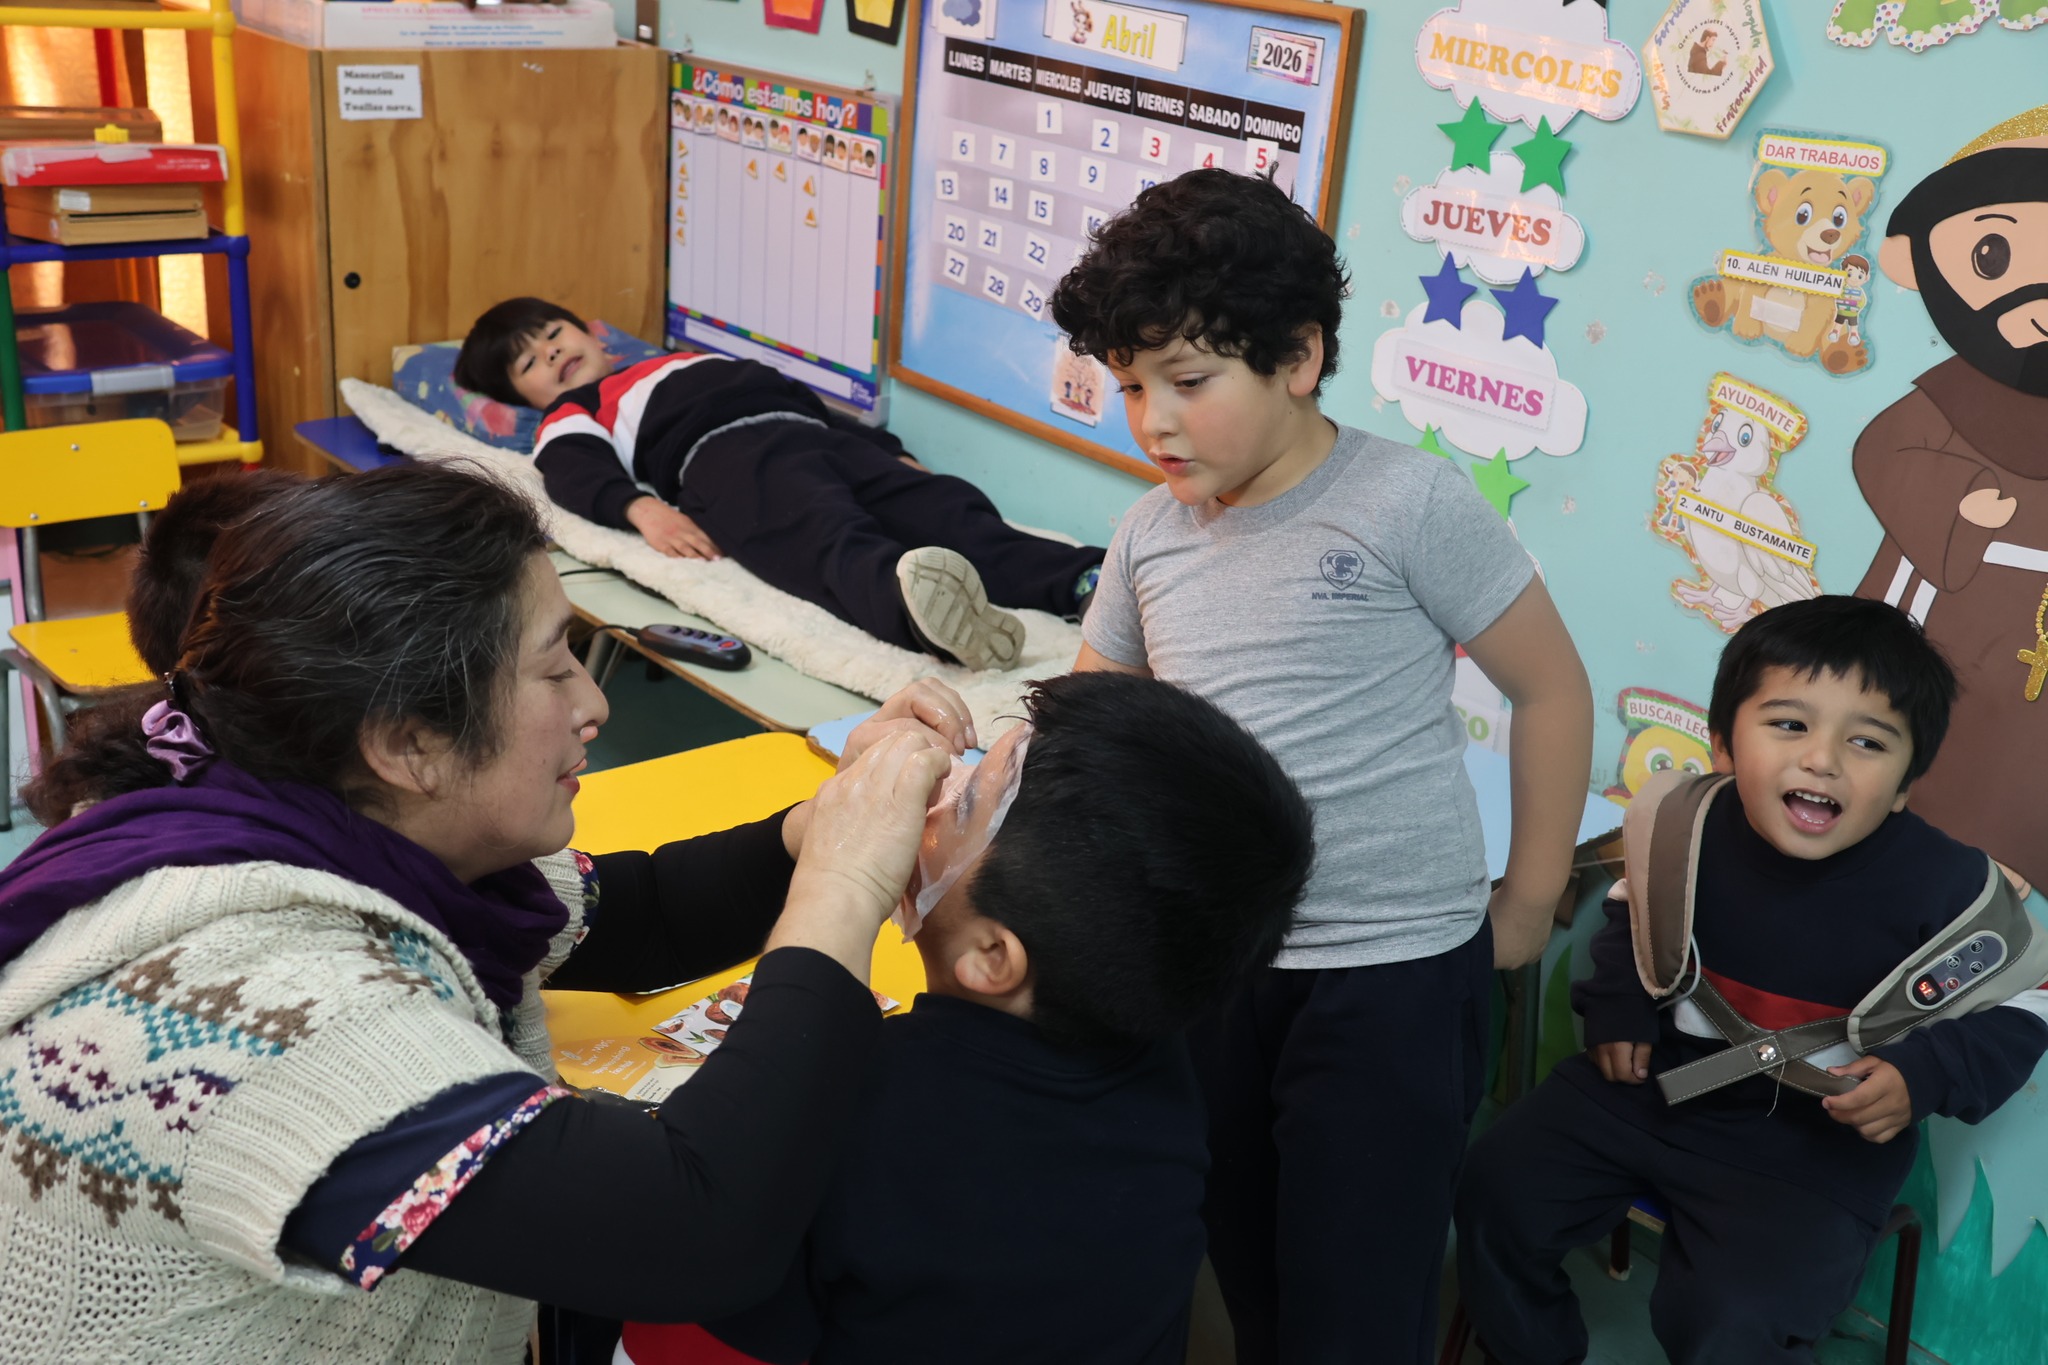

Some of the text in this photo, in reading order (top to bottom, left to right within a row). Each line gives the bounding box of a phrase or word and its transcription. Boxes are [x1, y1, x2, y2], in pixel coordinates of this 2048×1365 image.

[1101, 14, 1157, 59] Abril
[1654, 0, 1689, 46] Servici
[1262, 42, 1302, 73] 2026
[1429, 32, 1622, 99] MIERCOLES
[693, 69, 857, 129] ¿Cómo estamos hoy?
[948, 50, 1301, 143] LUNES MARTES MIERCOLES JUEVES VIERNES SABADO DOMINGO
[959, 138, 968, 156] 6
[998, 143, 1007, 160] 7
[1039, 158, 1049, 175] 8
[1088, 166, 1098, 183] 9
[1045, 109, 1267, 169] 1 2 3 4 5
[1765, 144, 1880, 170] DAR TRABAJOS
[941, 178, 954, 195] 13
[994, 186, 1008, 204] 14
[1034, 199, 1048, 218] 15
[948, 222, 1046, 264] 20 21 22
[1423, 200, 1551, 246] JUEVES
[948, 257, 1042, 313] 27 28 29
[1727, 257, 1842, 289] 10. ALÉN HUILIPÁN
[1405, 355, 1544, 416] VIERNES
[1717, 385, 1795, 433] AYUDANTE
[1679, 497, 1811, 559] 2. ANTU BUSTAMANTE
[1629, 702, 1710, 740] BUSCAR LEC
